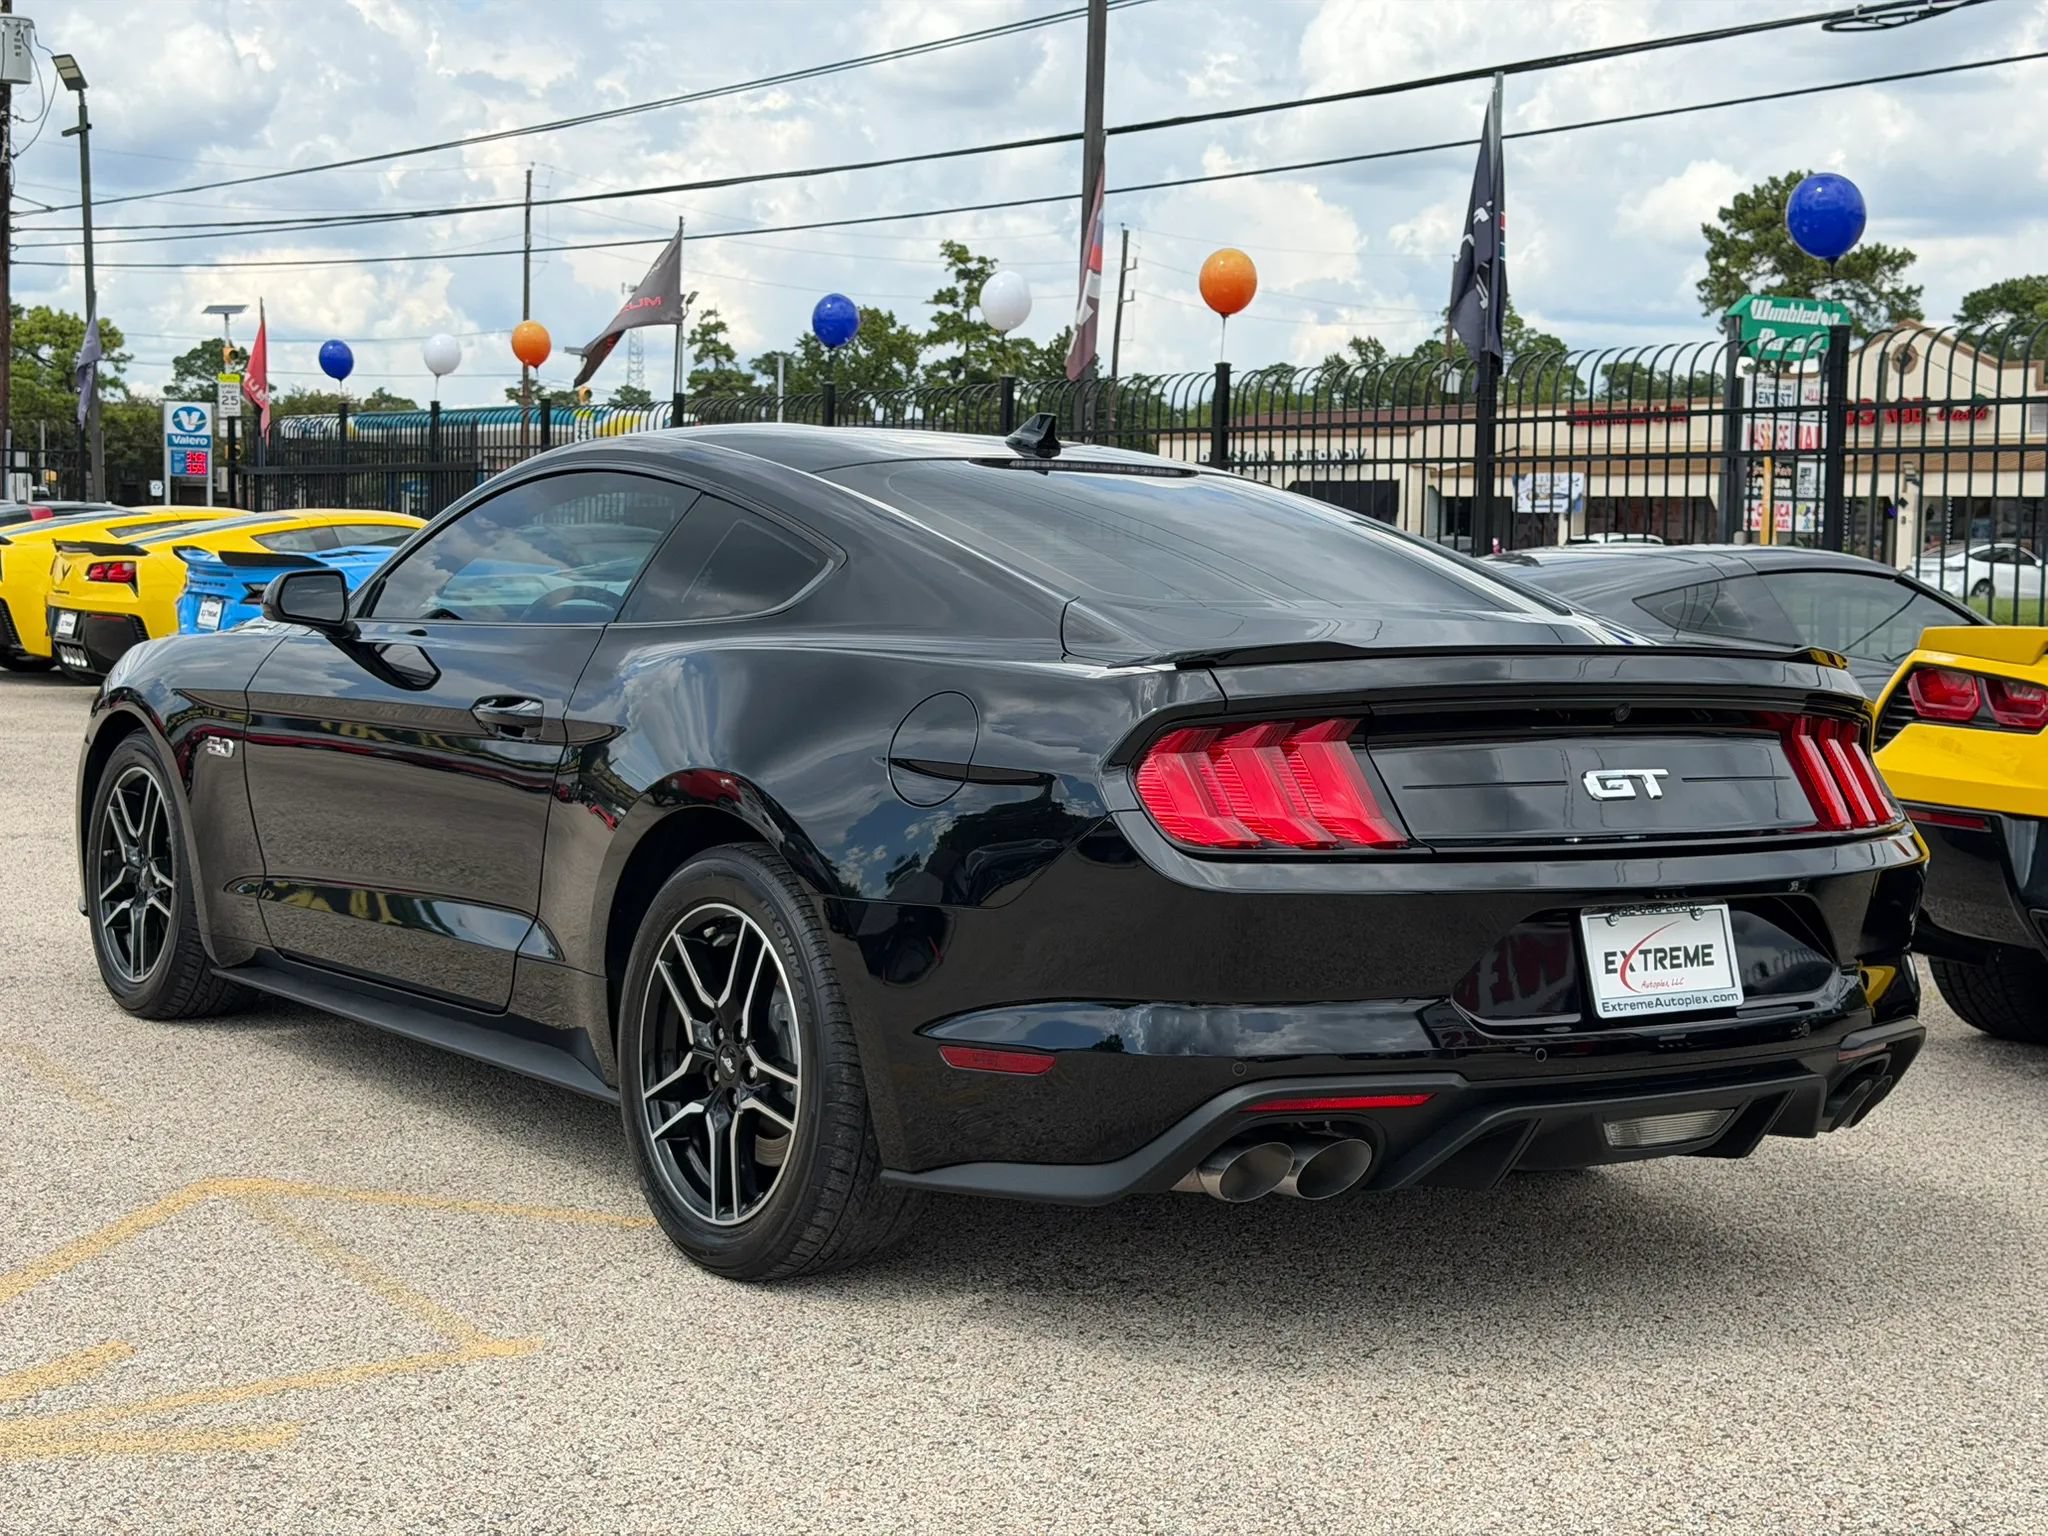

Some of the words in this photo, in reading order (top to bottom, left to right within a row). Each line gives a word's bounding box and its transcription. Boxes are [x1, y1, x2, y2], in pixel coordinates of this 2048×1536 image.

[1750, 299, 1841, 326] Wimbledon
[221, 395, 239, 406] 25
[1753, 391, 1792, 406] ENTST
[171, 435, 208, 446] Valero
[207, 735, 234, 758] 5.0
[1583, 768, 1669, 800] GT
[1604, 943, 1714, 974] EXTREME
[1671, 977, 1685, 986] LLC
[1602, 993, 1739, 1013] ExtremeAutoplex.com
